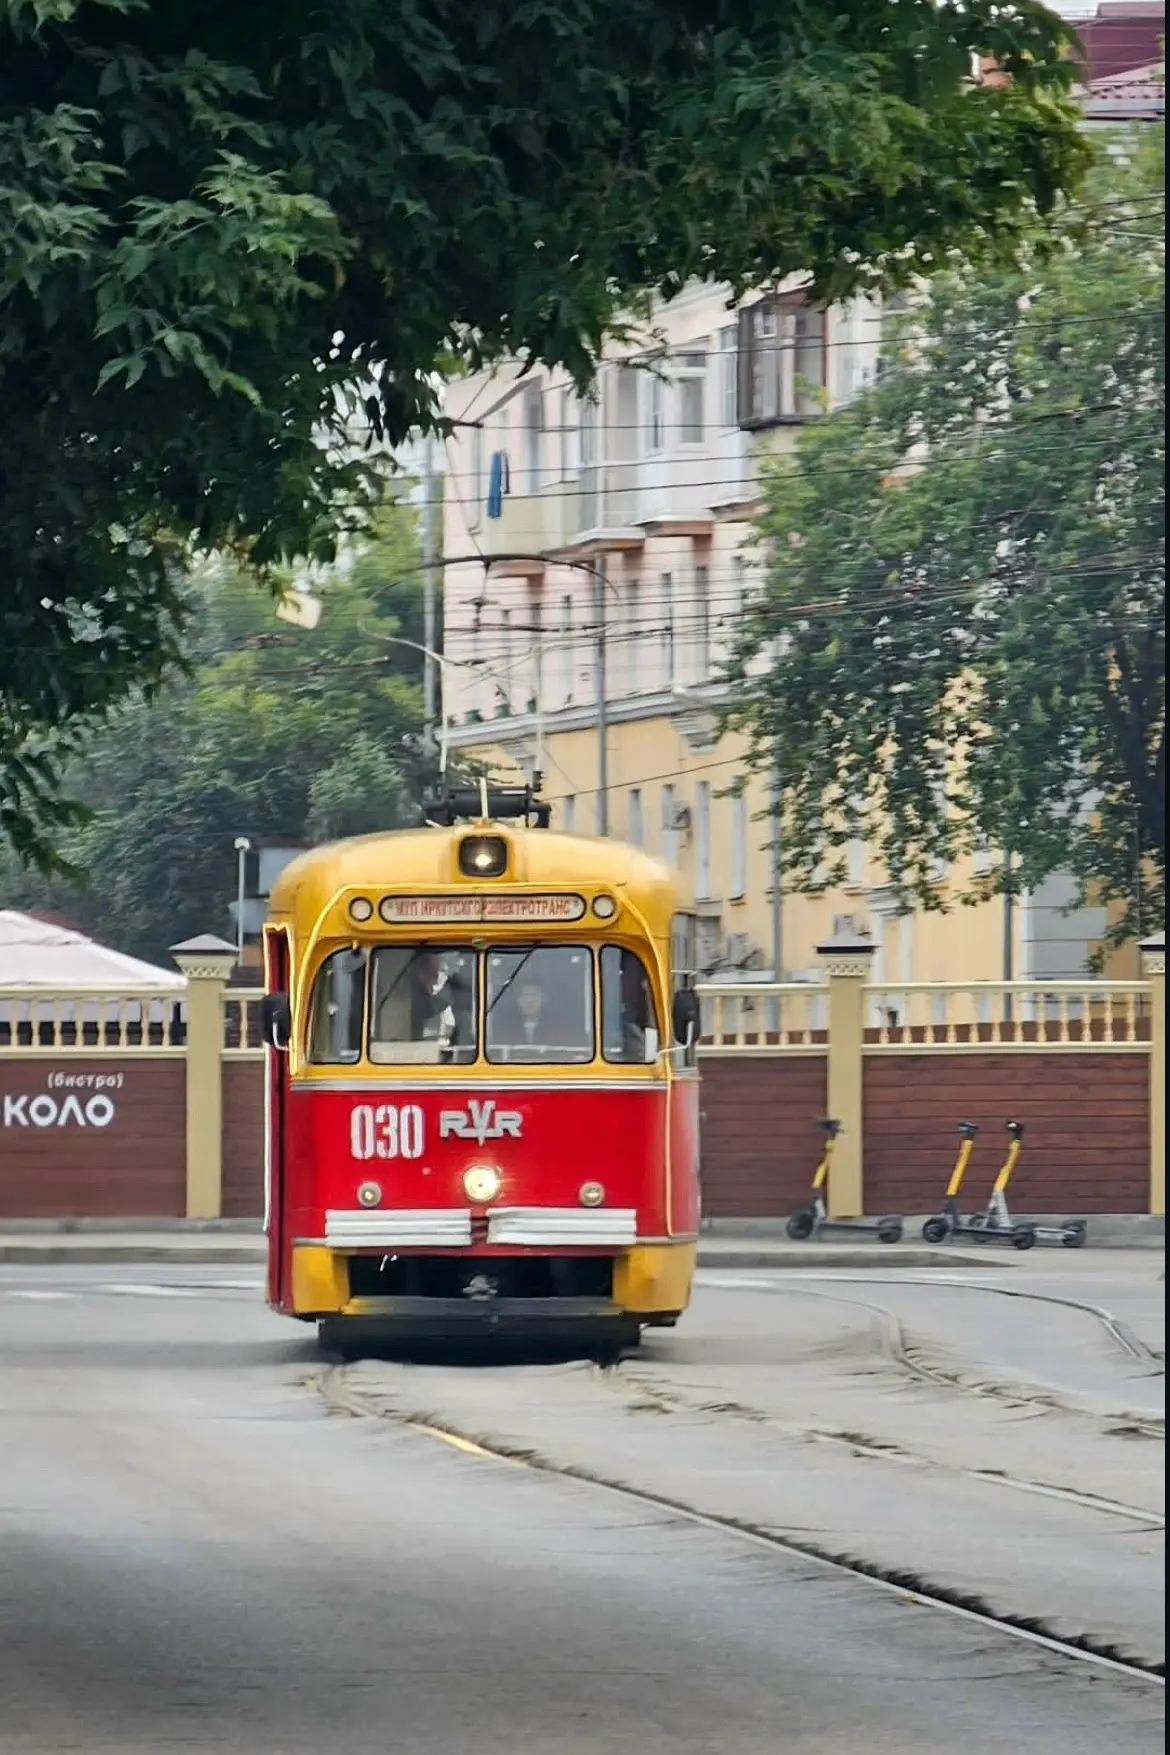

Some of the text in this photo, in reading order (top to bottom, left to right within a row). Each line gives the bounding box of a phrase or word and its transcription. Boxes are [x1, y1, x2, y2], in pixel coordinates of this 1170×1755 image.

[48, 1072, 124, 1088] (бистро)
[351, 1104, 425, 1160] 030
[439, 1099, 524, 1147] RVR
